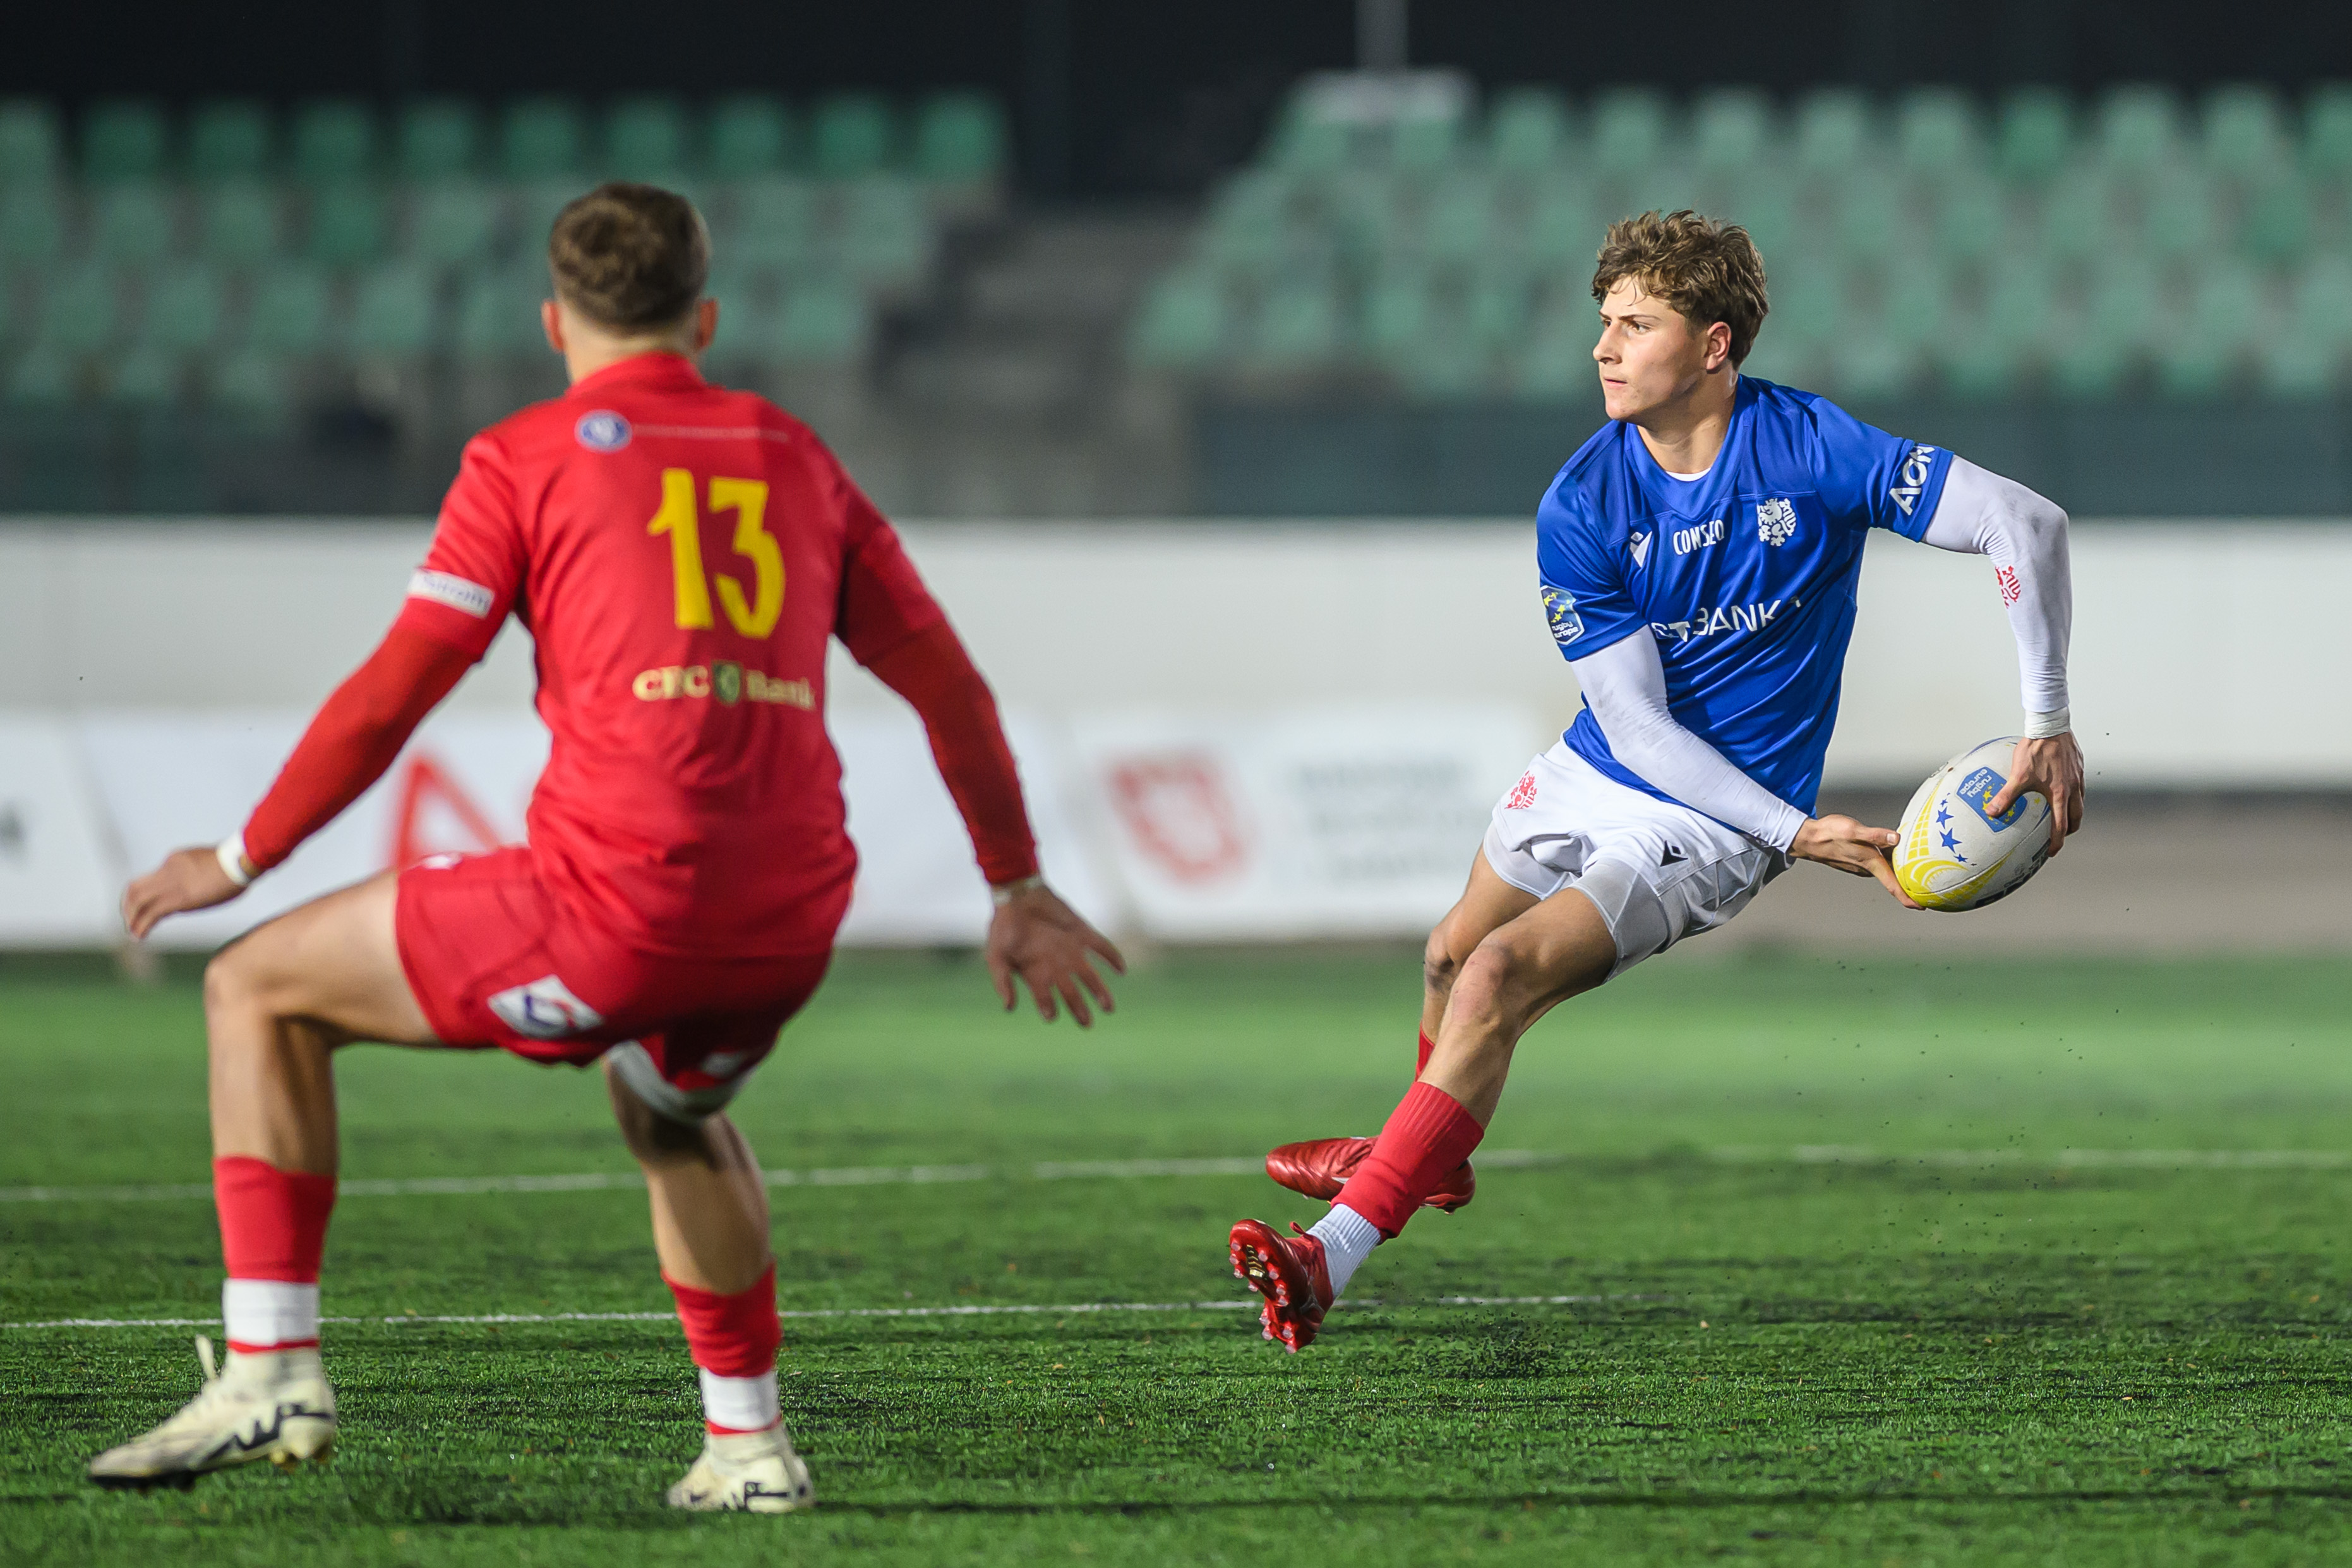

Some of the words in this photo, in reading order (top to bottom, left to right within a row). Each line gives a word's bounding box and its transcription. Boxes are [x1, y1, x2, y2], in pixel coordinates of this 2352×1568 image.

[1888, 445, 1935, 516] AON
[646, 467, 786, 640] 13
[1673, 519, 1725, 556] CONSEQ
[1693, 595, 1801, 637] BANK
[1959, 769, 1988, 795] europe
[1966, 774, 1993, 798] rugby
